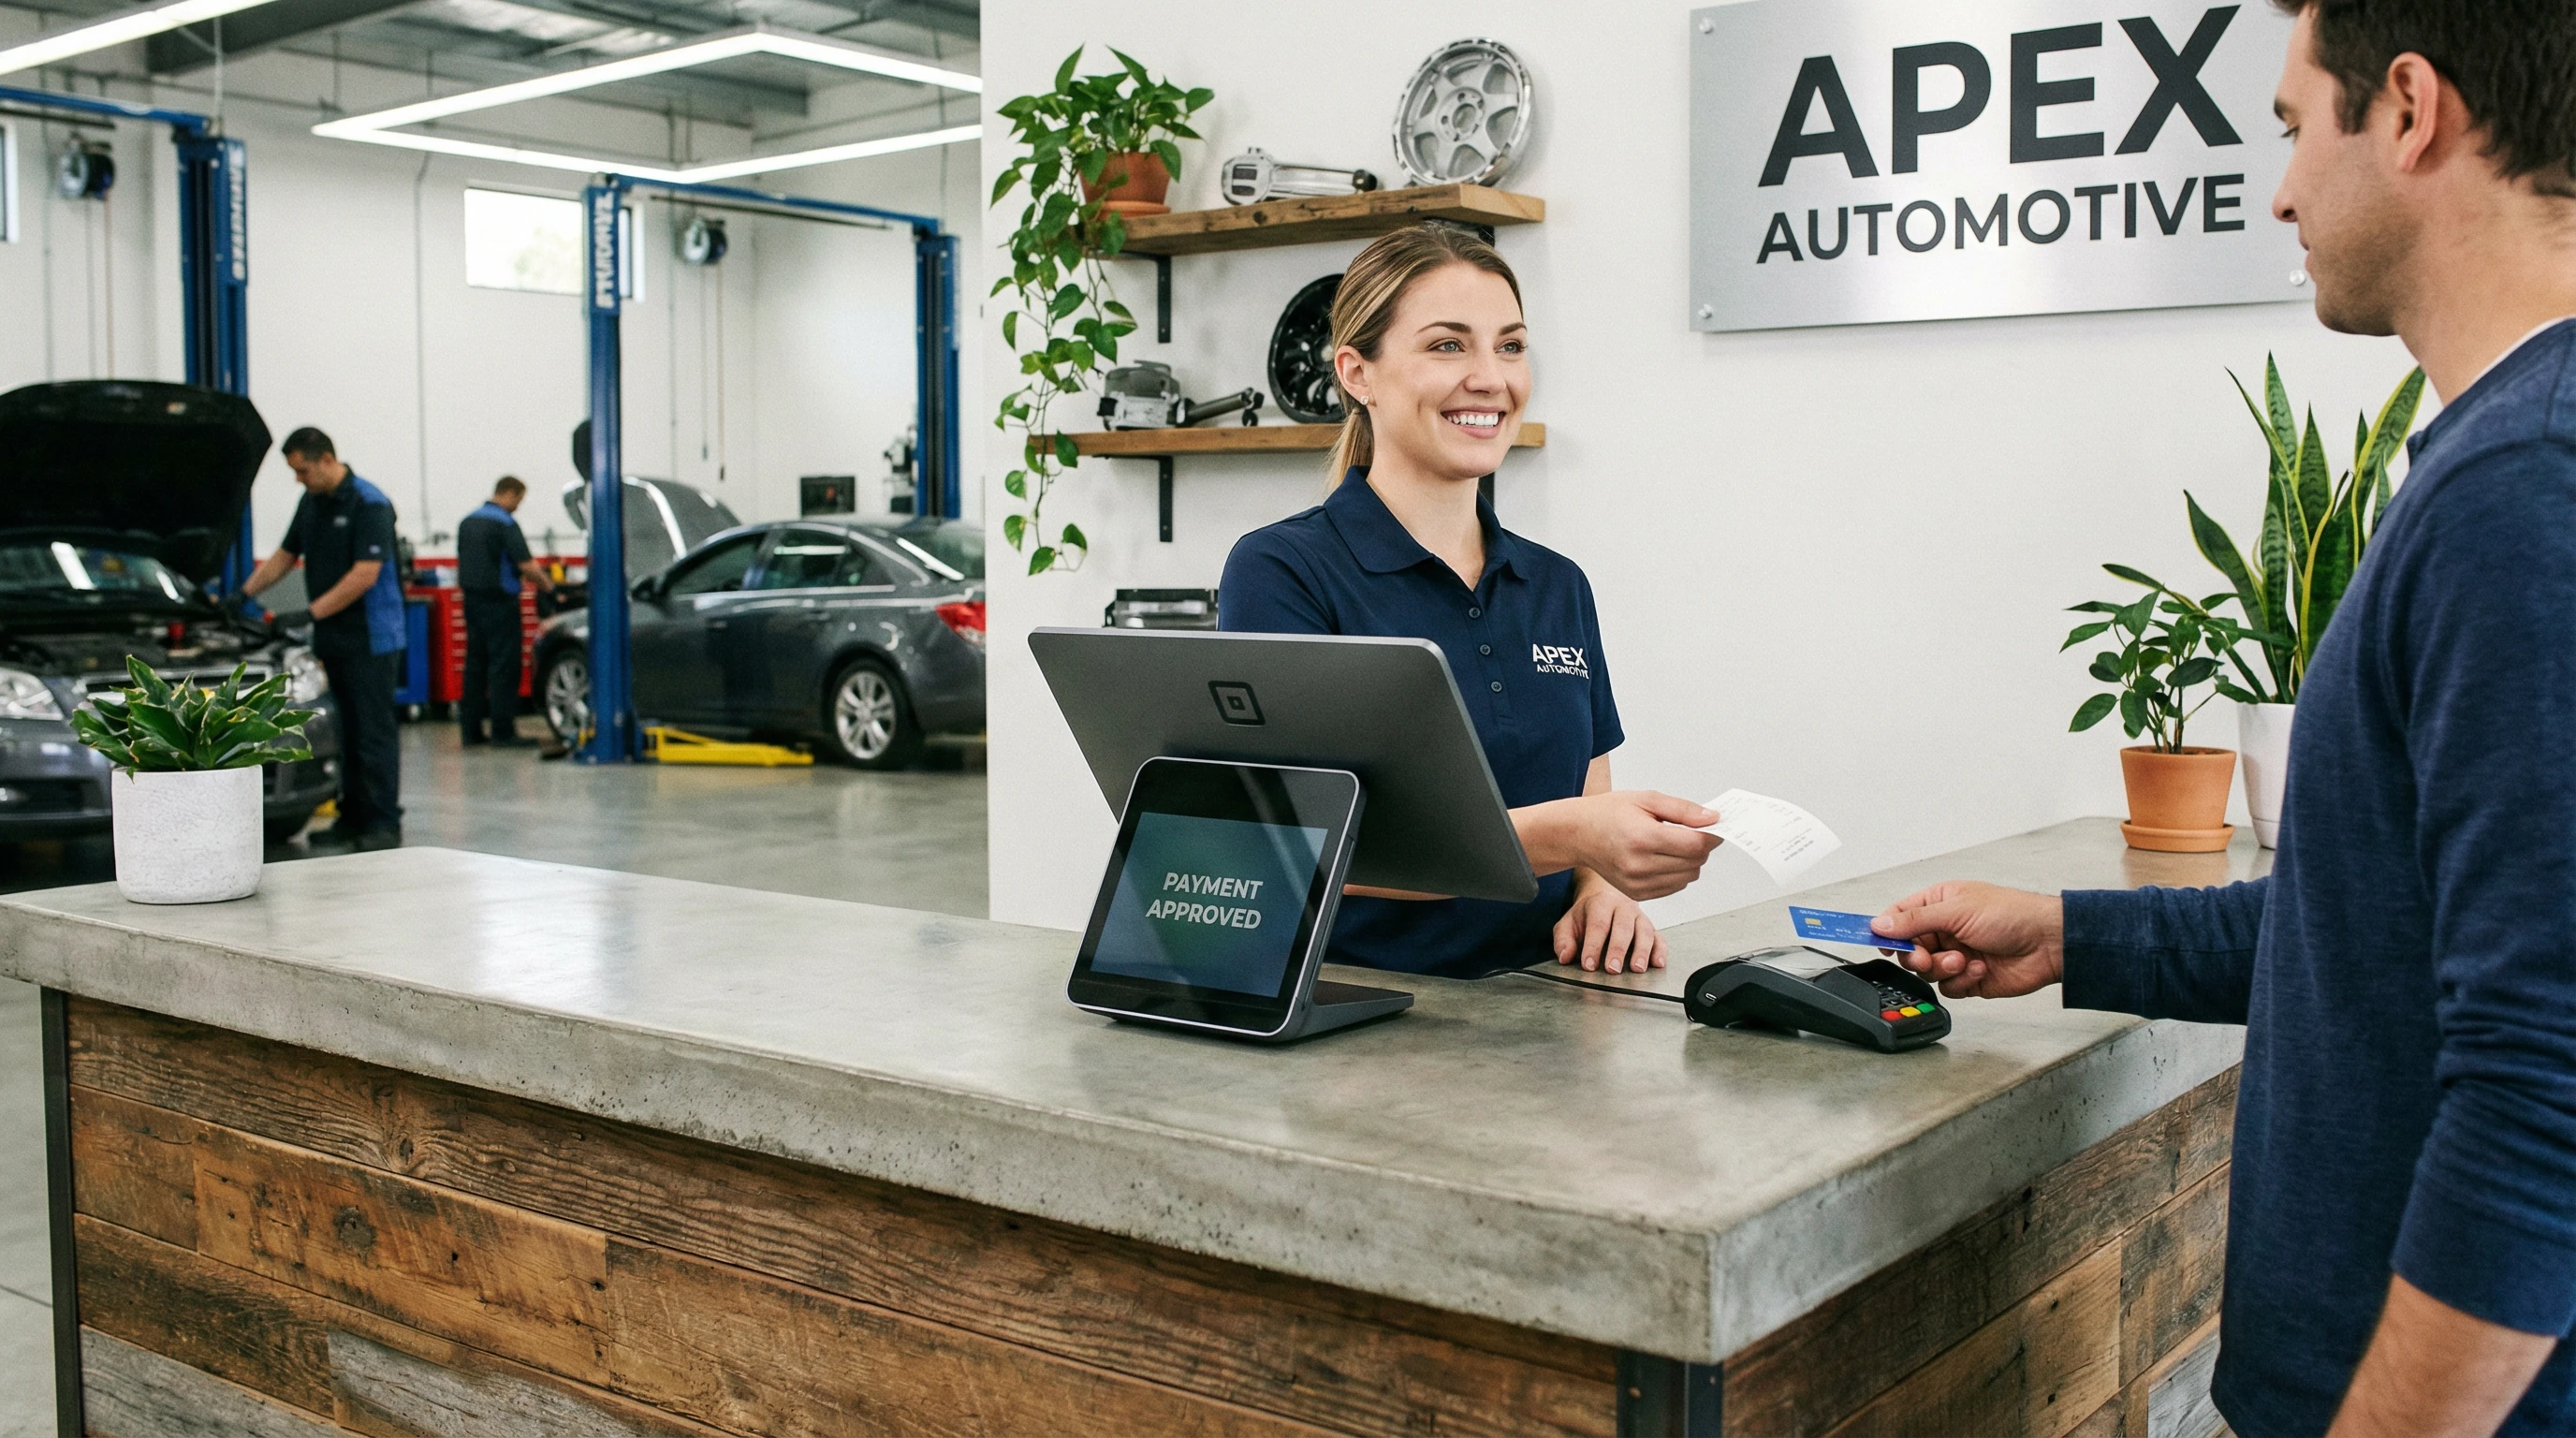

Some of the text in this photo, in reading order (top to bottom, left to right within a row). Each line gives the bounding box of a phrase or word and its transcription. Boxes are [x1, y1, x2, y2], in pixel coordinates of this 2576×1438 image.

[1757, 4, 2244, 188] APEX
[1756, 173, 2246, 265] AUTOMOTIVE
[1532, 643, 1588, 669] APEX
[1163, 872, 1264, 900] PAYMENT
[1145, 899, 1262, 930] APPROVED
